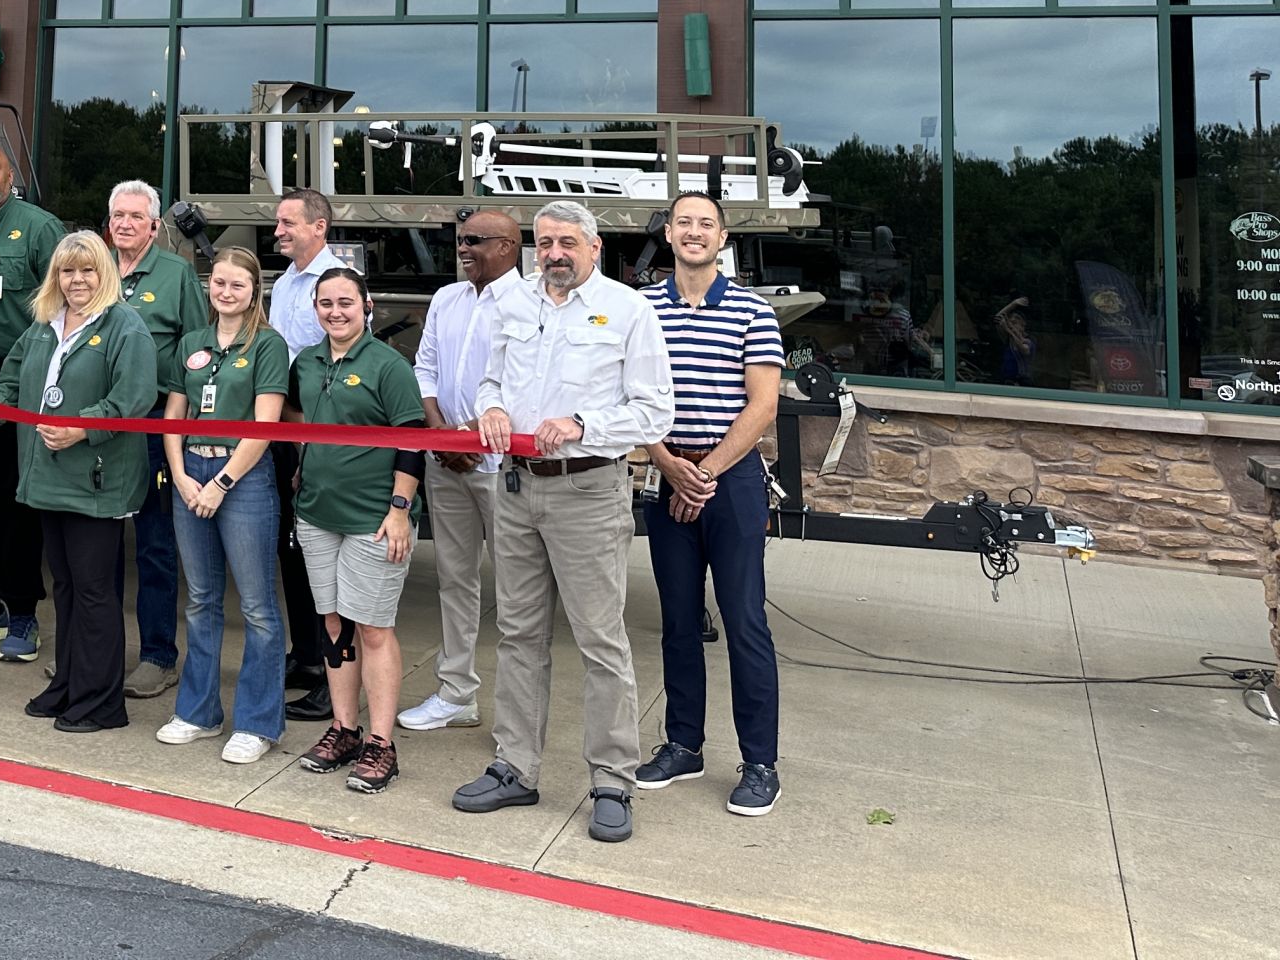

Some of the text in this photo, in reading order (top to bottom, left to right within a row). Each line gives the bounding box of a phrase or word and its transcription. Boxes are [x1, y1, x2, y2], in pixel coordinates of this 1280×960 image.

[1251, 212, 1271, 222] Bass
[1252, 221, 1268, 229] Pro
[1252, 228, 1278, 238] Shops
[1261, 248, 1280, 259] MO
[1236, 260, 1263, 271] 9:00
[1236, 289, 1267, 300] 10:00
[792, 348, 812, 358] DEAD
[791, 354, 813, 364] DOWN
